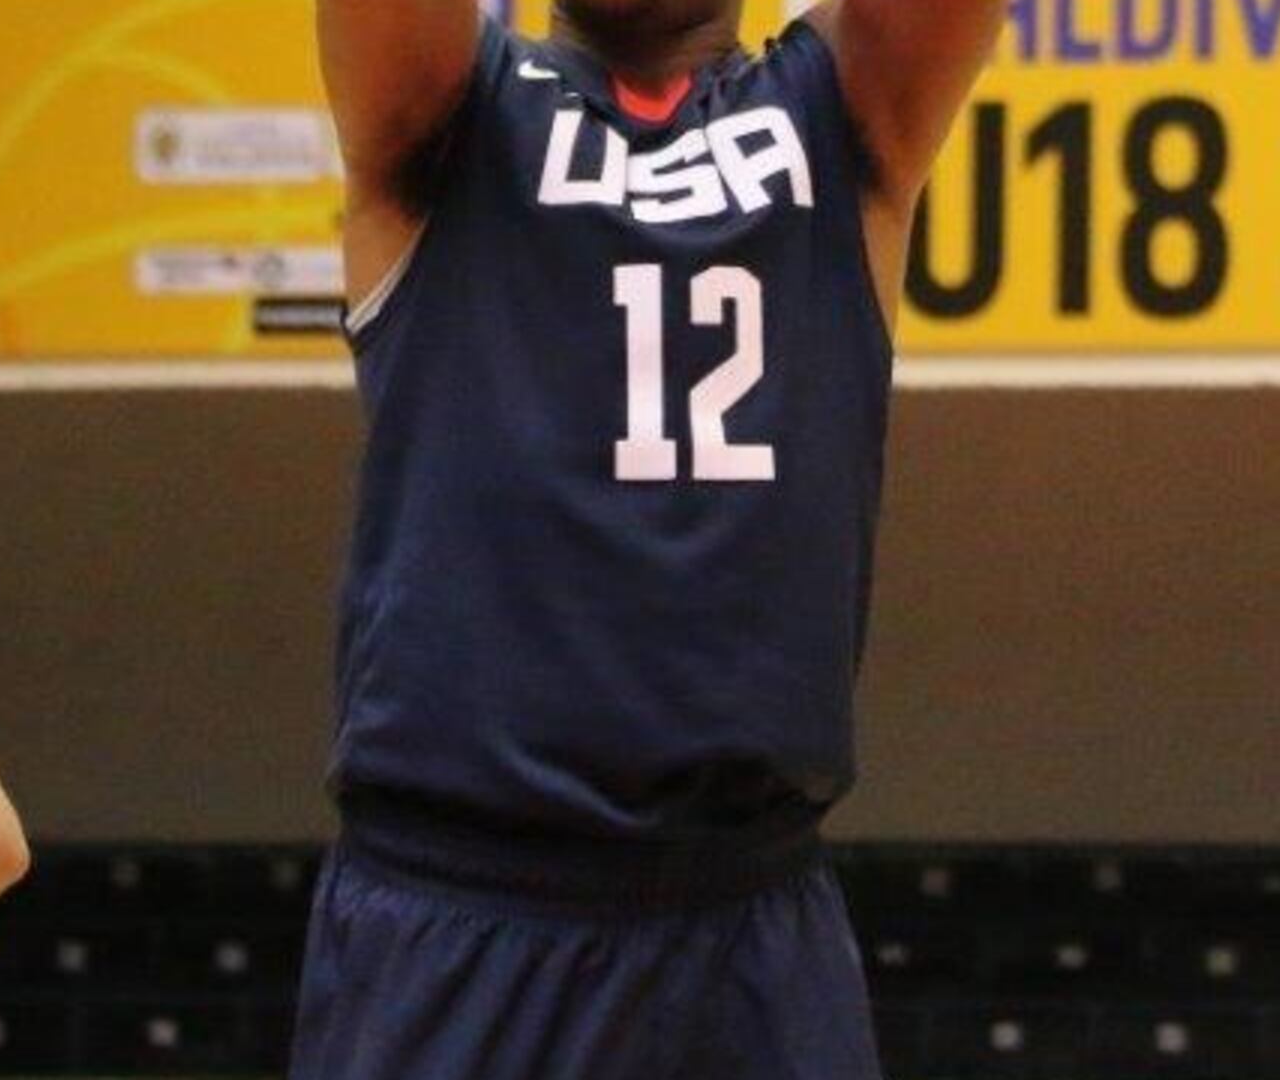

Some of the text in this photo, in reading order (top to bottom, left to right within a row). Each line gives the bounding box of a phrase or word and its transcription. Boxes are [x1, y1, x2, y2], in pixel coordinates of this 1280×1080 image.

[536, 106, 815, 224] USA
[904, 92, 1230, 320] U18
[611, 262, 776, 482] 12
